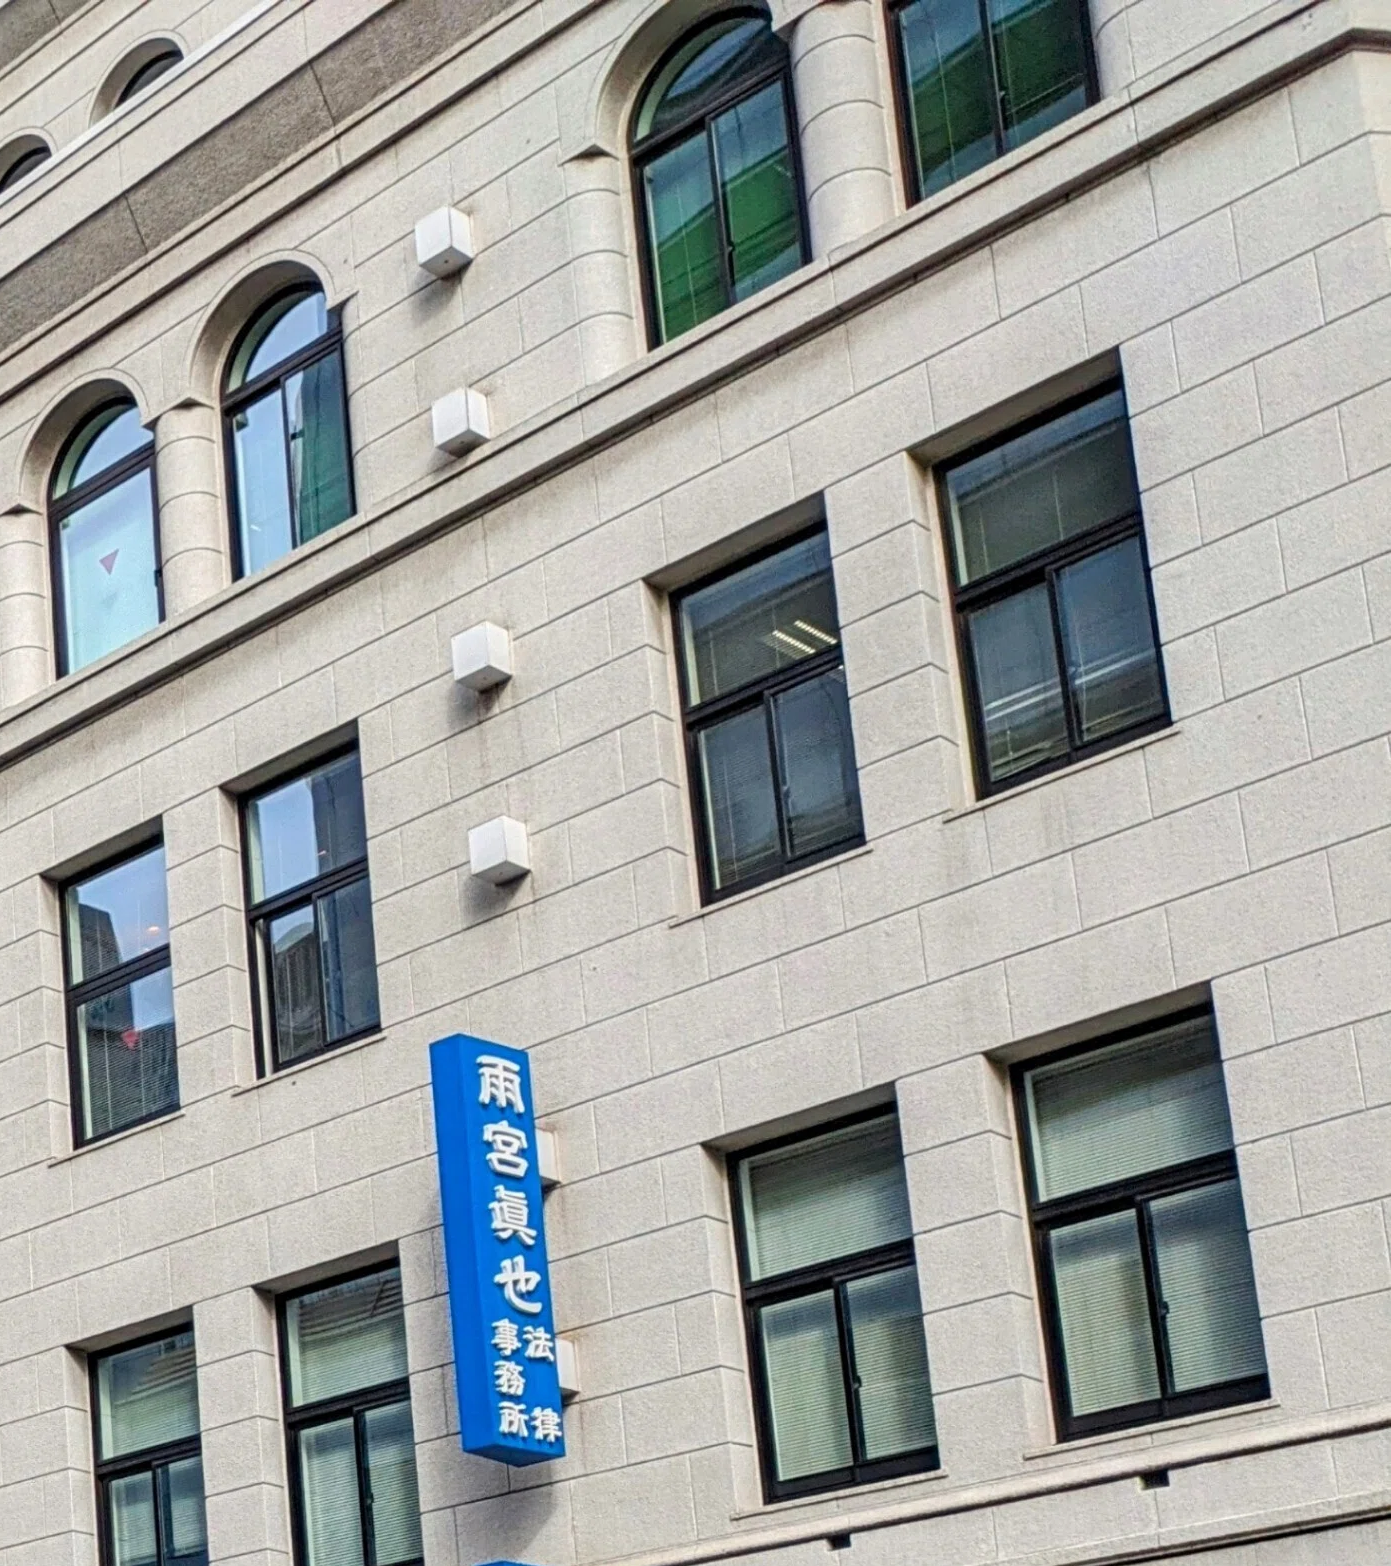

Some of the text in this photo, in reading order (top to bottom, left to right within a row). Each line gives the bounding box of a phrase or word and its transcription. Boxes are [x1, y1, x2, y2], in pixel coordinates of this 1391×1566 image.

[475, 1054, 544, 1314] 雨宮眞也
[491, 1319, 528, 1438] 事務所
[522, 1325, 563, 1442] 法律
